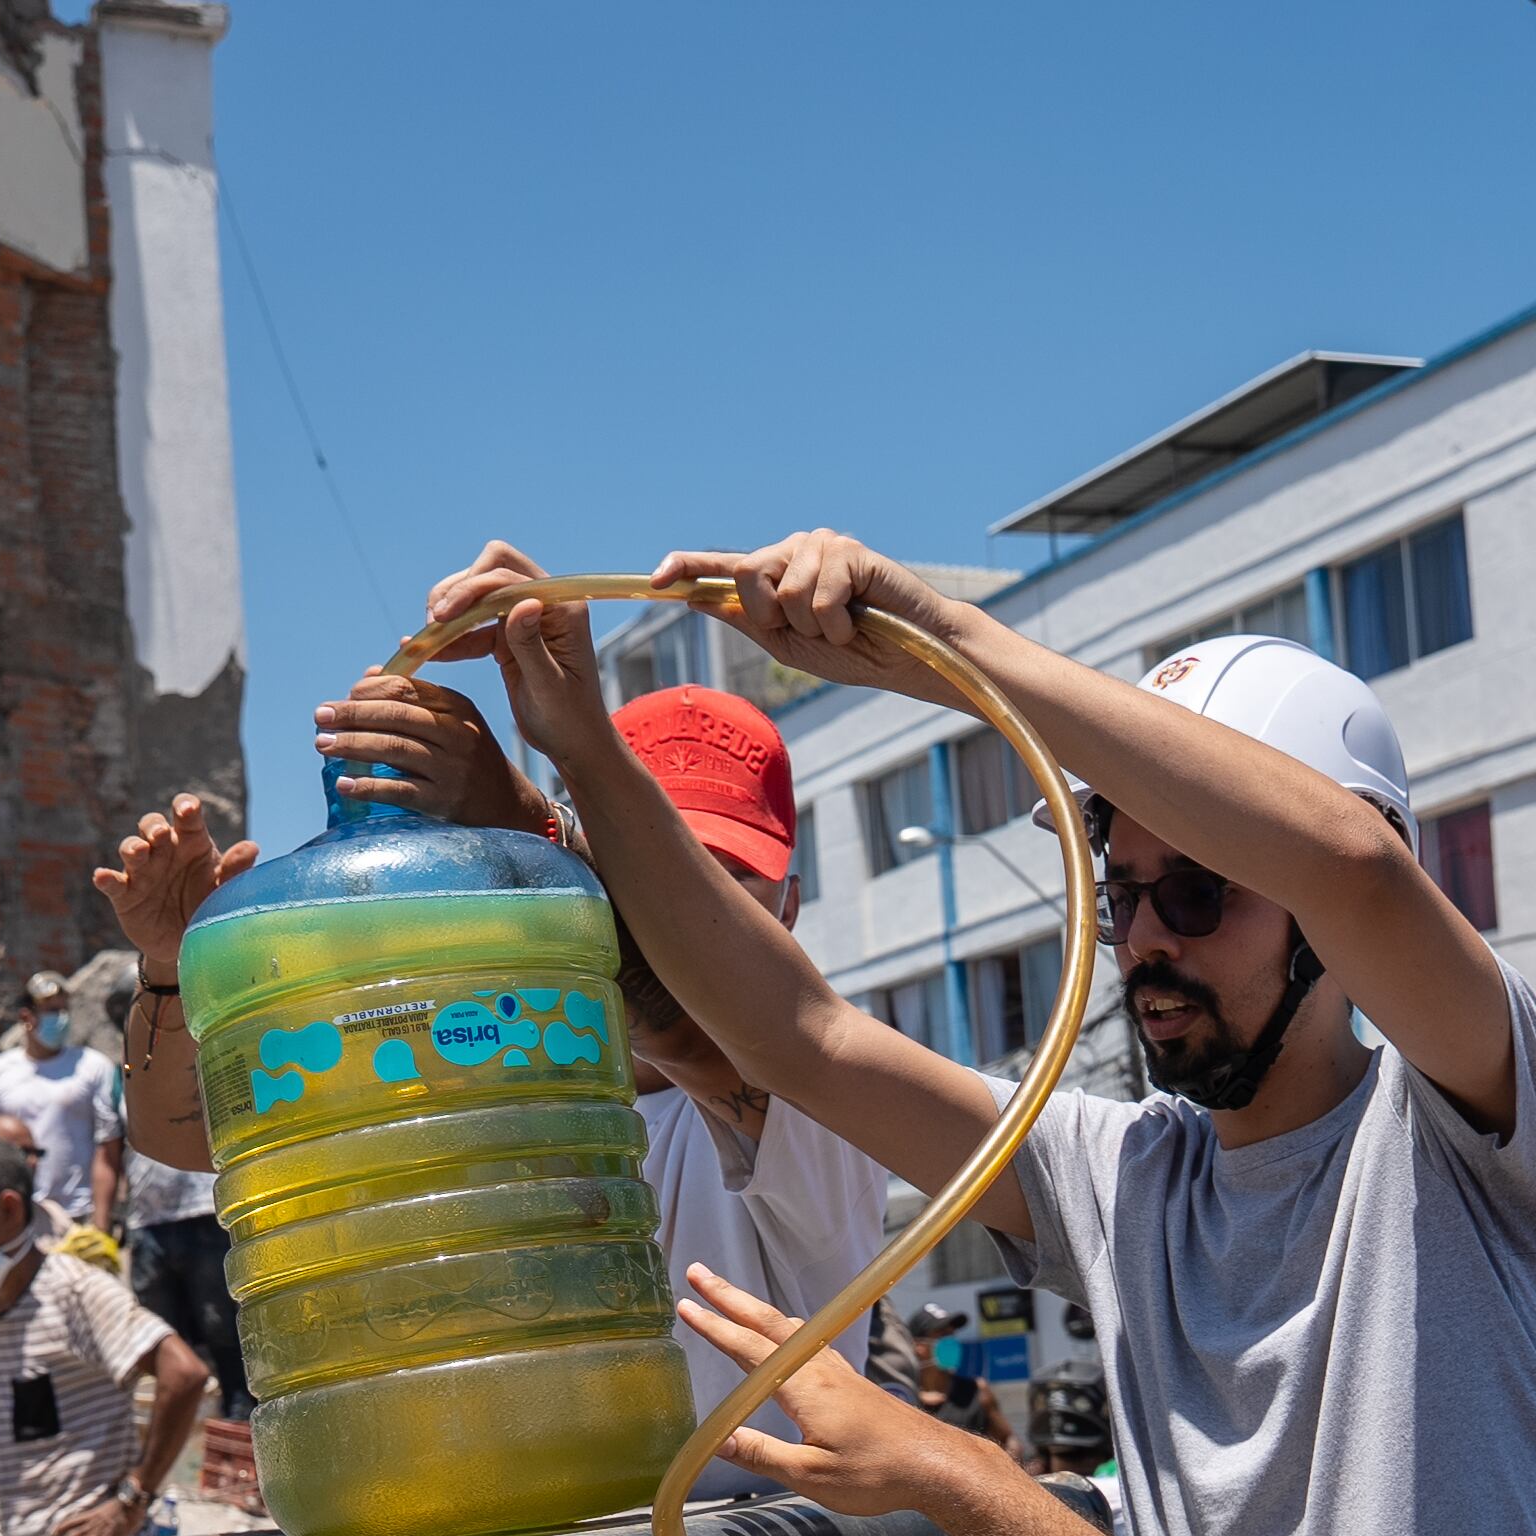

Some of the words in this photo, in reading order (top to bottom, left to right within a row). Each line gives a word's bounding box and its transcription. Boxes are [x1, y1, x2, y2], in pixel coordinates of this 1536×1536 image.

[343, 1001, 428, 1023] RETORNABLE
[408, 1012, 428, 1022] AGUA
[343, 1019, 375, 1034] TRATADA
[376, 1014, 408, 1028] POTABLE
[436, 1024, 501, 1048] brisa
[231, 1101, 253, 1116] brisa
